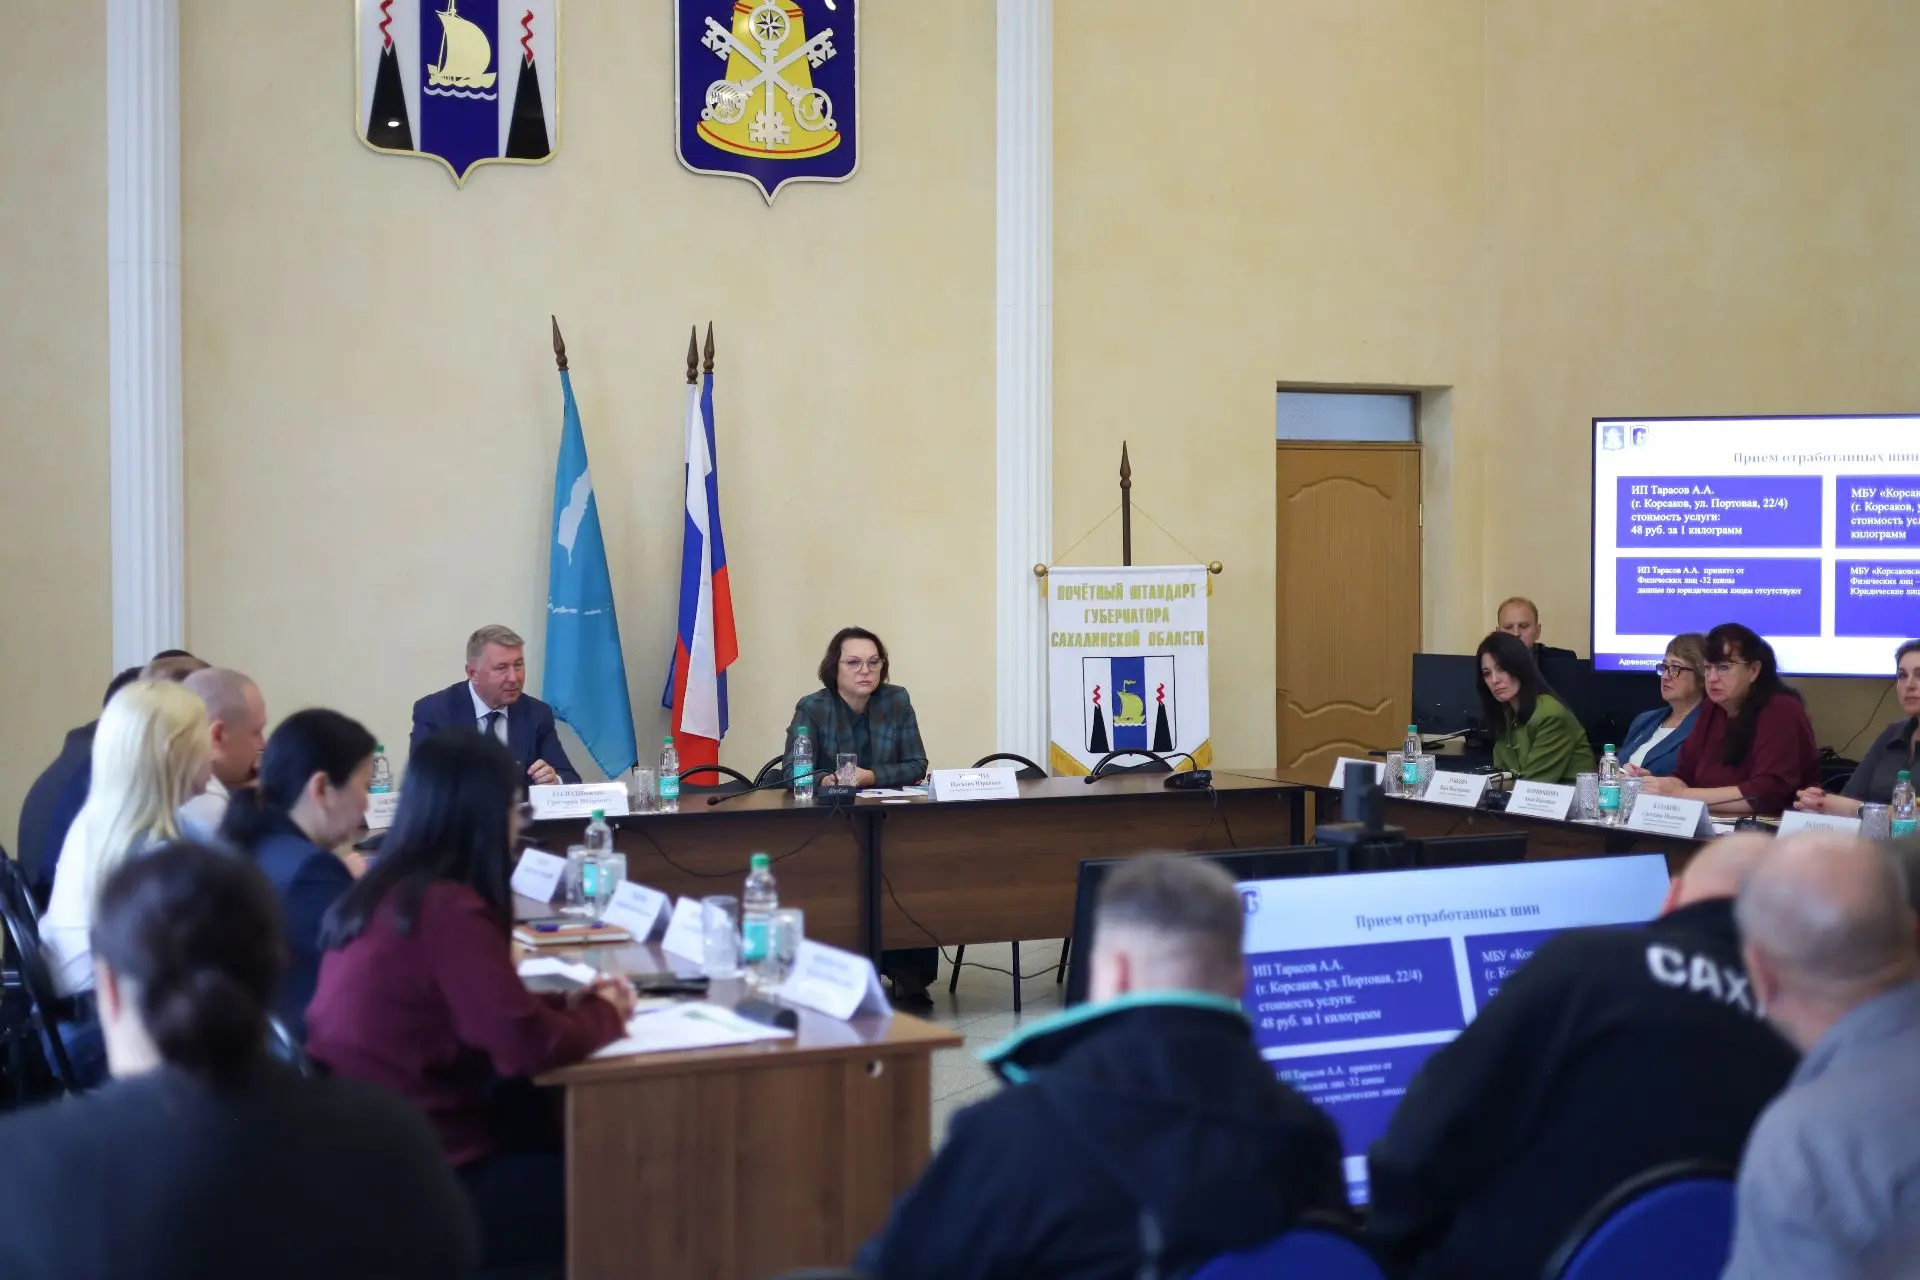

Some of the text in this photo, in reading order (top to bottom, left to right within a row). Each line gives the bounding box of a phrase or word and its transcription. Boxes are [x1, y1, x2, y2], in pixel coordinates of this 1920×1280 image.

[1734, 452, 1778, 465] Прием
[1782, 452, 1884, 466] отработанных
[1631, 485, 1715, 497] ИП Тарасов А.А.
[1851, 488, 1877, 498] МБУ
[1631, 498, 1788, 510] (г. Корсаков, ул. Портовая, 22/4)
[1851, 502, 1862, 513] (г.
[1865, 502, 1914, 514] Корсаков,
[1631, 513, 1721, 523] стоимость услуги:
[1851, 517, 1904, 525] стоимость
[1631, 526, 1642, 535] 48
[1645, 525, 1665, 536] руб.
[1668, 527, 1678, 535] за
[1689, 527, 1742, 536] килограмм
[1851, 530, 1906, 540] килограмм
[1637, 566, 1650, 574] ИП
[1652, 566, 1681, 575] Тарасов
[1683, 566, 1700, 574] А.А.
[1851, 567, 1869, 575] МБУ
[1850, 577, 1897, 585] Физических
[1057, 583, 1196, 601] ПОЧЁТНЫЙ ШТАНДАРТ
[1755, 588, 1802, 596] отсутствуют
[1084, 607, 1169, 624] ГУБЕРНАТОРА
[1051, 629, 1204, 647] САХАЛИНСКОЙ ОБЛАСТИ
[1355, 904, 1541, 931] Прием отработанных шин
[1481, 949, 1507, 963] МБУ
[1253, 960, 1344, 978] ИП Тарасов А.А.
[1270, 980, 1322, 995] Корсаков,
[1342, 973, 1394, 989] Портовая,
[1396, 969, 1423, 984] 22/4)
[1646, 942, 1766, 1018] САХ
[1258, 994, 1356, 1013] стоимость услуги:
[1261, 1017, 1274, 1029] 48
[1277, 1015, 1298, 1032] руб.
[1324, 1009, 1381, 1024] килограмм
